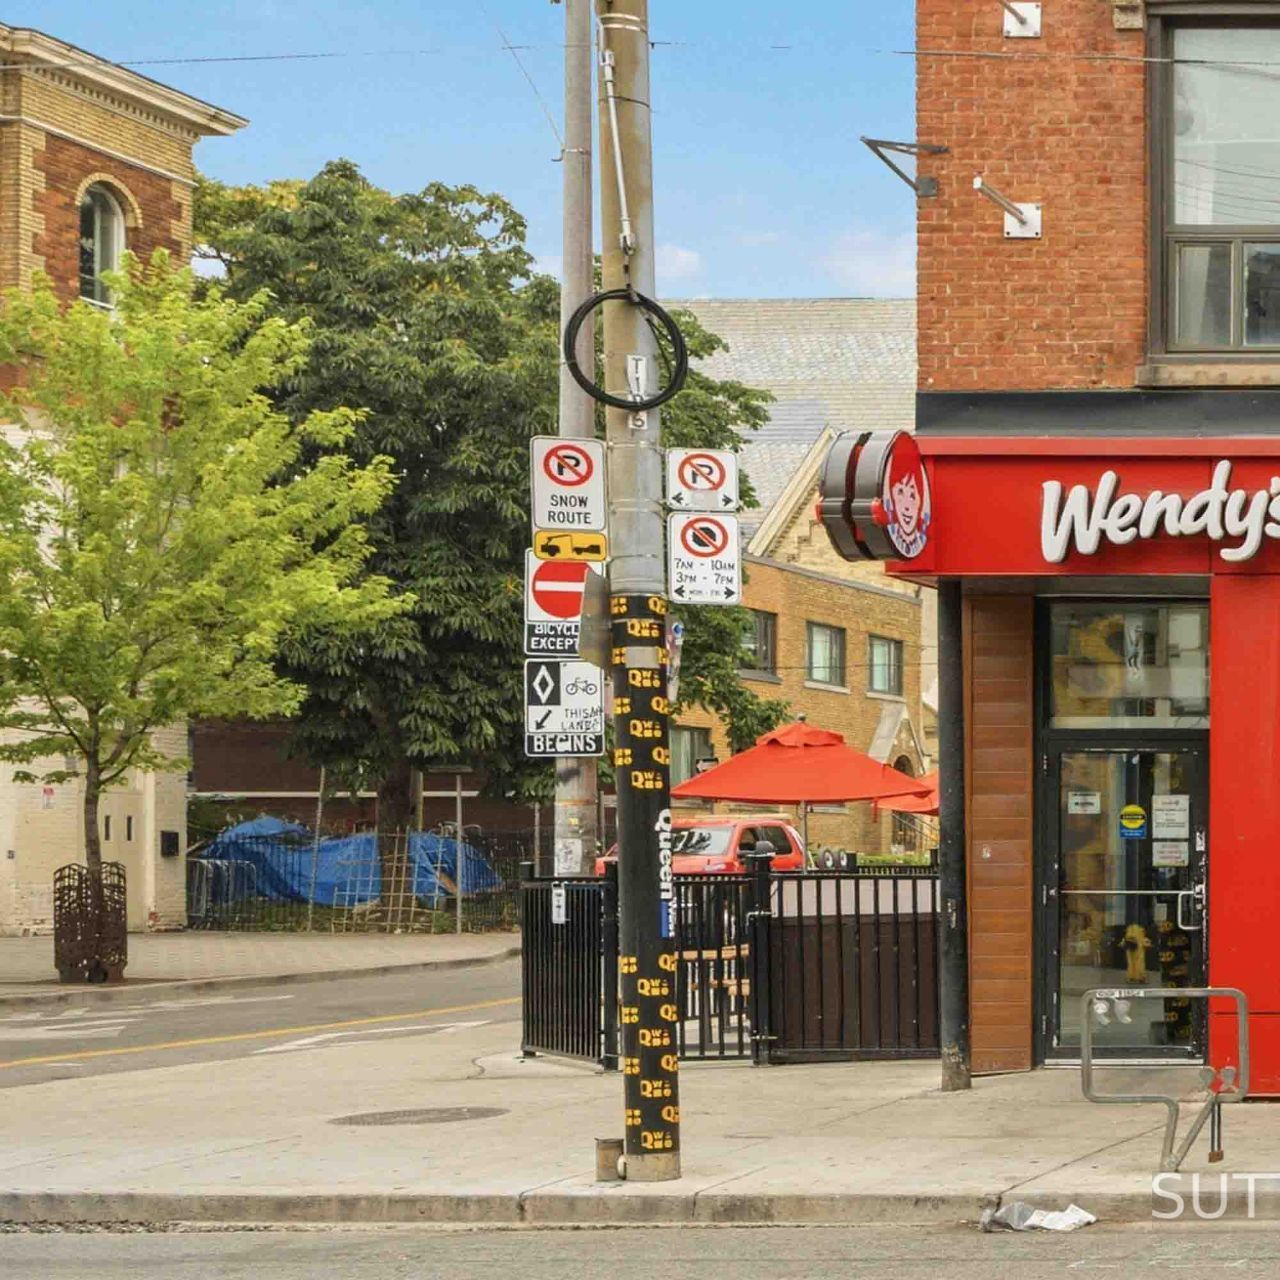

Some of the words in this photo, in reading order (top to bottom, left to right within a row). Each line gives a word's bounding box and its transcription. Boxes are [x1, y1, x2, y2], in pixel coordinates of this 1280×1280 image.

[550, 494, 588, 507] SNOW
[547, 510, 592, 525] ROUTE
[534, 623, 580, 635] BICYCL
[531, 637, 579, 650] EXCEPT
